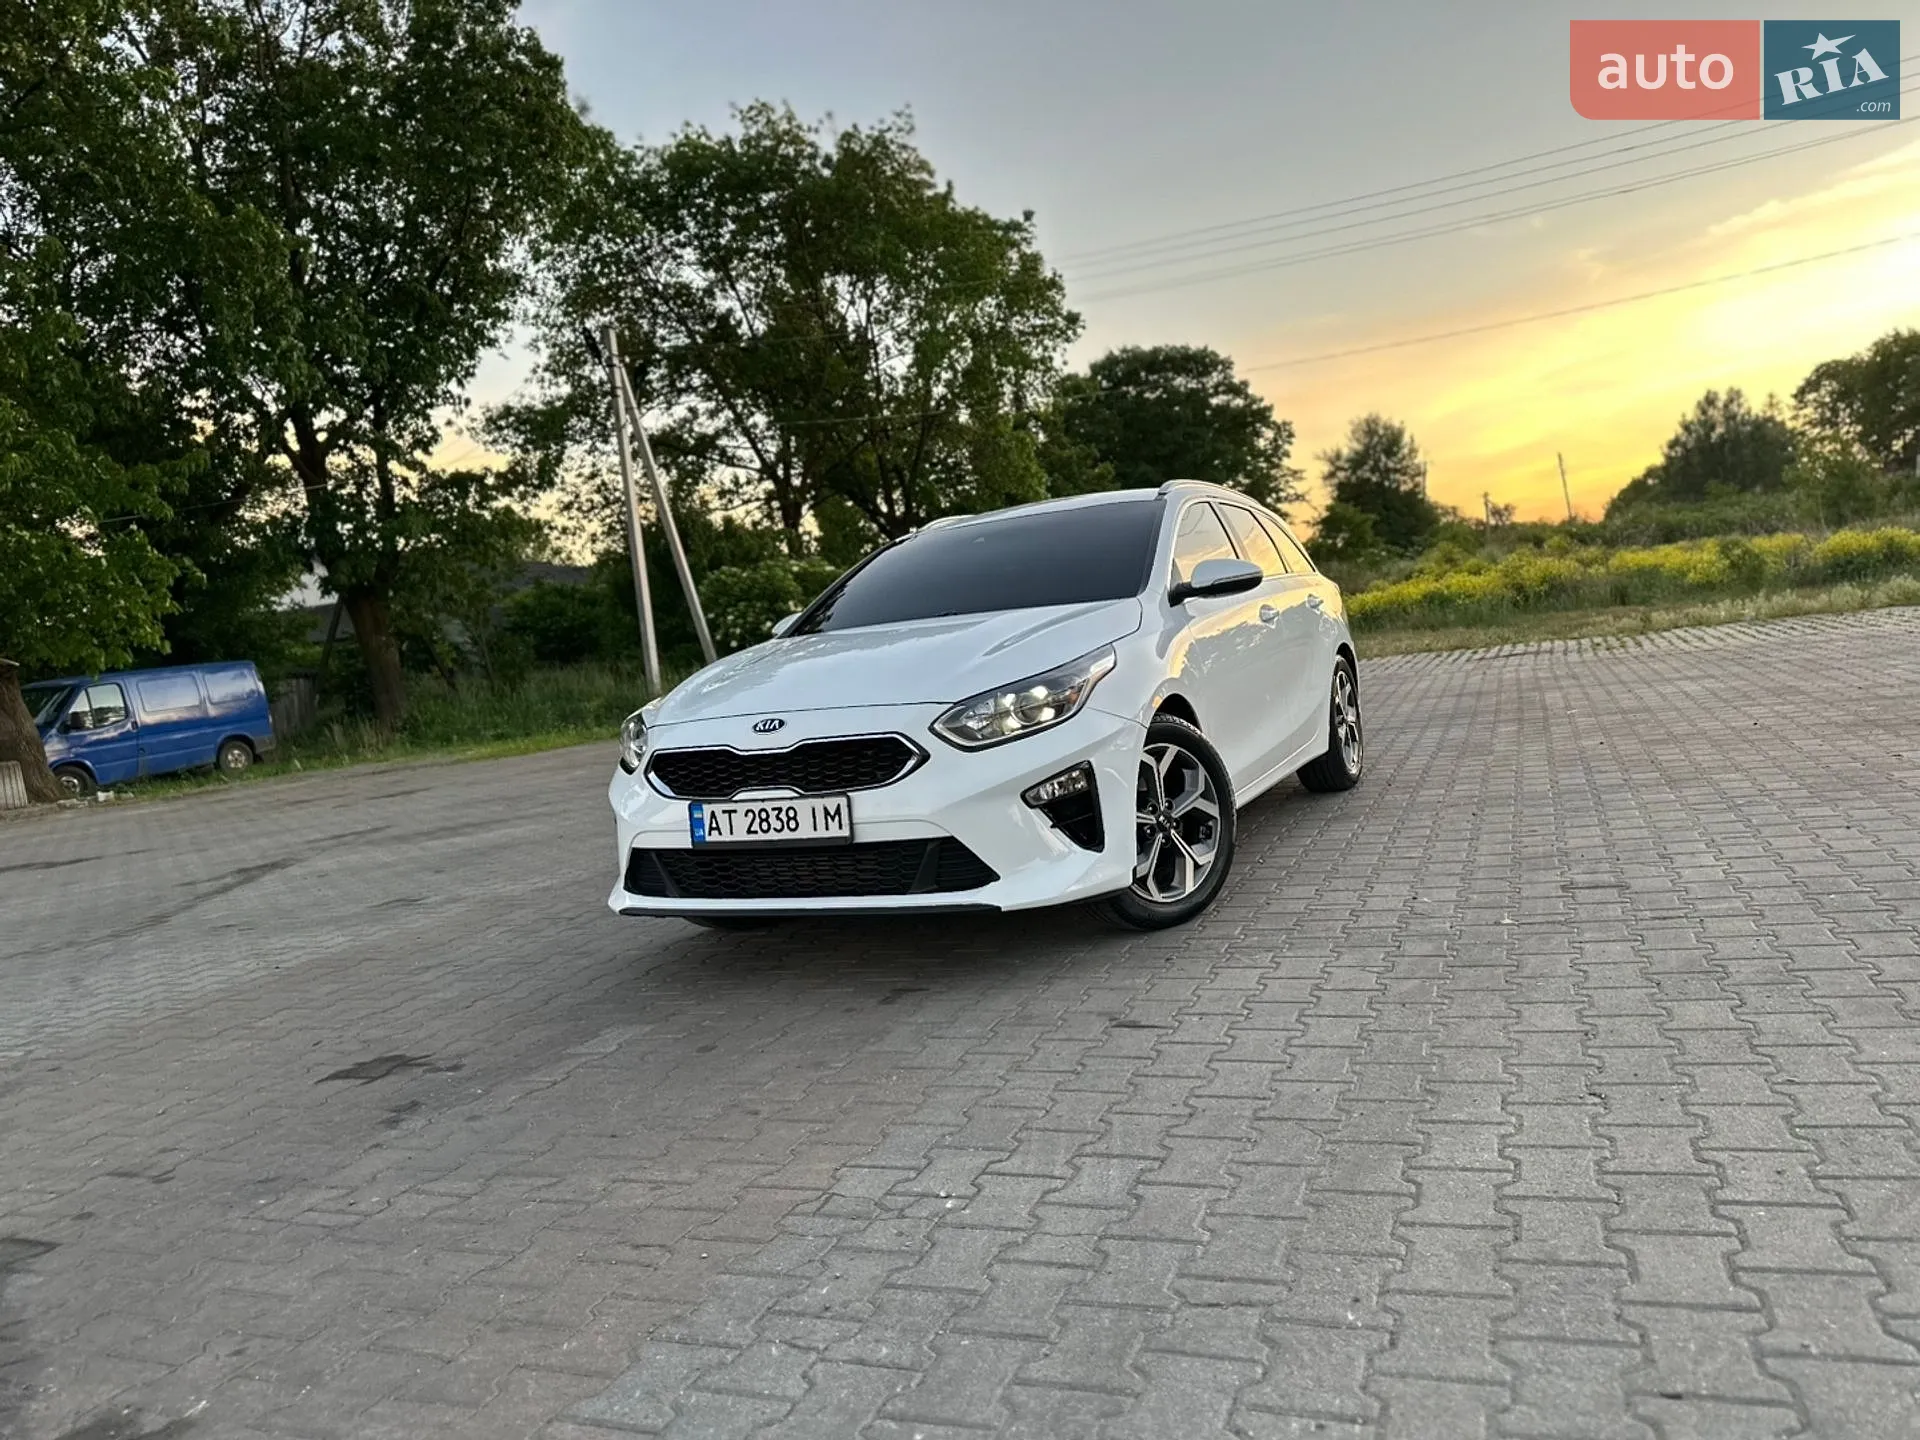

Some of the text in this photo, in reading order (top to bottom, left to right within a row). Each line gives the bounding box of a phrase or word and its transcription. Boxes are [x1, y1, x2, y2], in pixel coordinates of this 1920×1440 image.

[755, 720, 780, 732] KIA
[708, 803, 843, 836] AT 2838 IM
